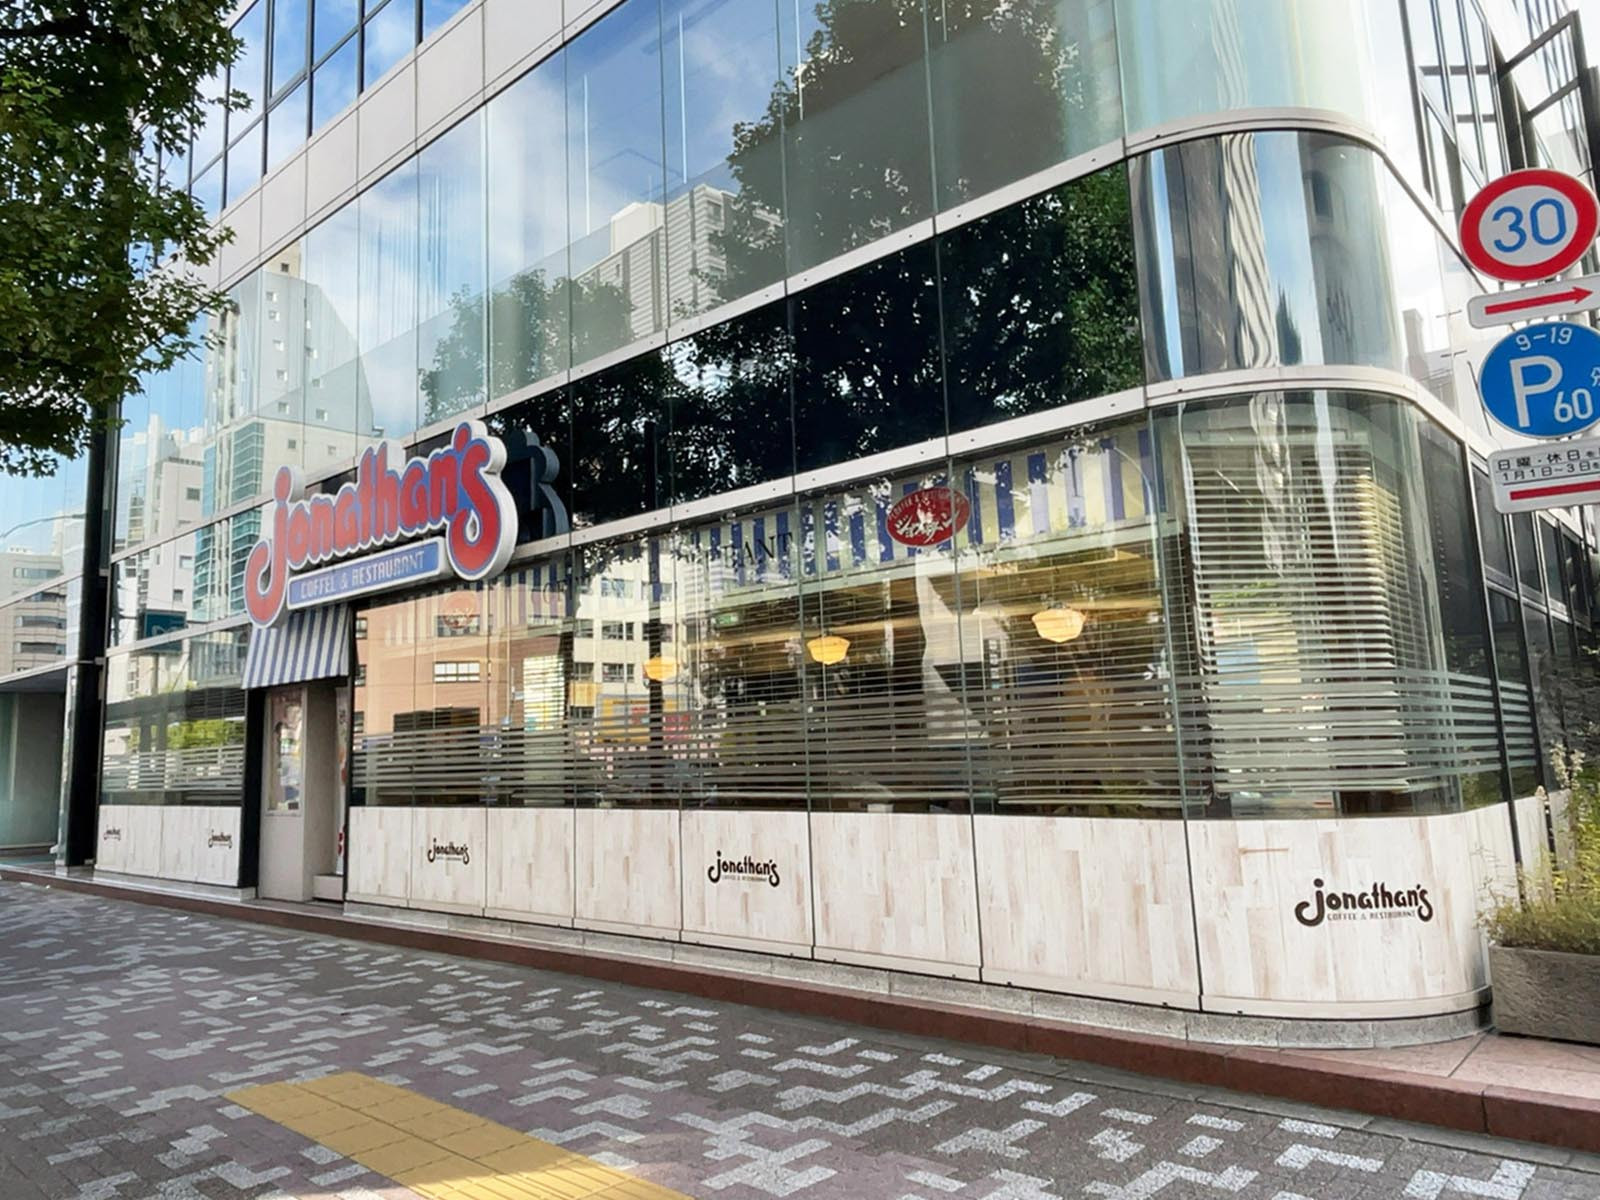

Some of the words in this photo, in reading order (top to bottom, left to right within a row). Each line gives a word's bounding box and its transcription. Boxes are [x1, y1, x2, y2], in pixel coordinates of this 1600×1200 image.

[1492, 198, 1567, 253] 30
[1516, 327, 1572, 351] 9-19
[1509, 355, 1563, 427] P
[1554, 388, 1593, 423] 60
[245, 422, 502, 627] jonathan's
[351, 551, 424, 587] RESTAURANT
[707, 850, 780, 888] jonathan's
[1294, 878, 1434, 927] jonathan's
